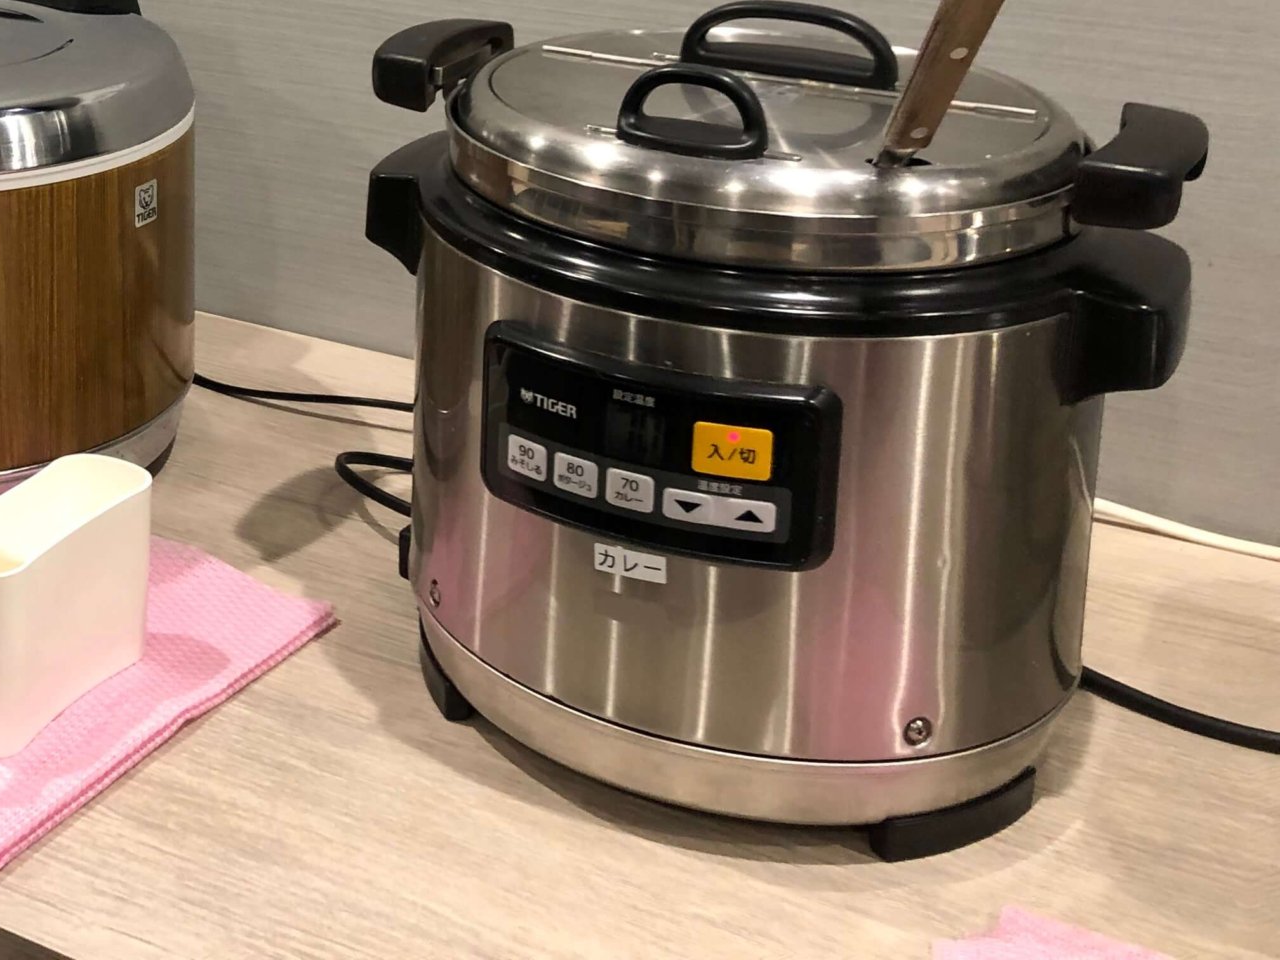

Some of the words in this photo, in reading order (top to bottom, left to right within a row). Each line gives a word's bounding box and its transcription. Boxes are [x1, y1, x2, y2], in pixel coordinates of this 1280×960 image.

[136, 206, 157, 224] TIGER
[535, 394, 577, 419] TIGER
[613, 388, 655, 408] 設定温度
[518, 445, 535, 460] 90
[511, 455, 542, 475] みそしる
[566, 462, 584, 477] 80
[558, 474, 592, 492] ポタージュ
[620, 477, 639, 492] 70
[697, 479, 742, 496] 温度設定
[614, 491, 644, 504] カレー
[598, 548, 662, 573] カレー
